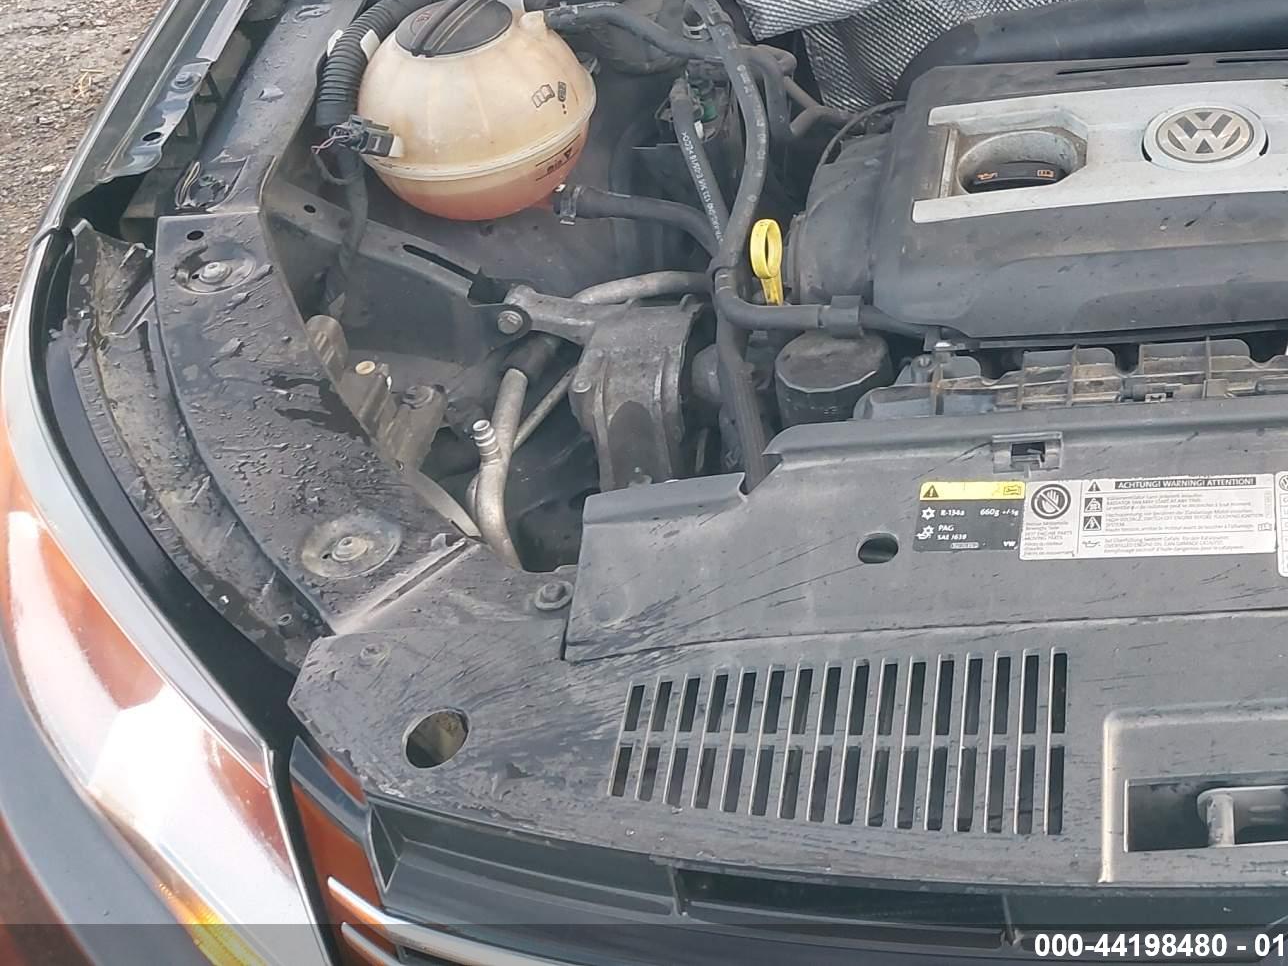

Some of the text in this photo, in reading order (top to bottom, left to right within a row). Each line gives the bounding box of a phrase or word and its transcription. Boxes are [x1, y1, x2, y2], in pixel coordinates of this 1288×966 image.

[1118, 477, 1254, 489] ACHTUNG! WARNING! ATTENTION!
[980, 508, 1000, 518] 660g
[938, 523, 955, 532] PAG
